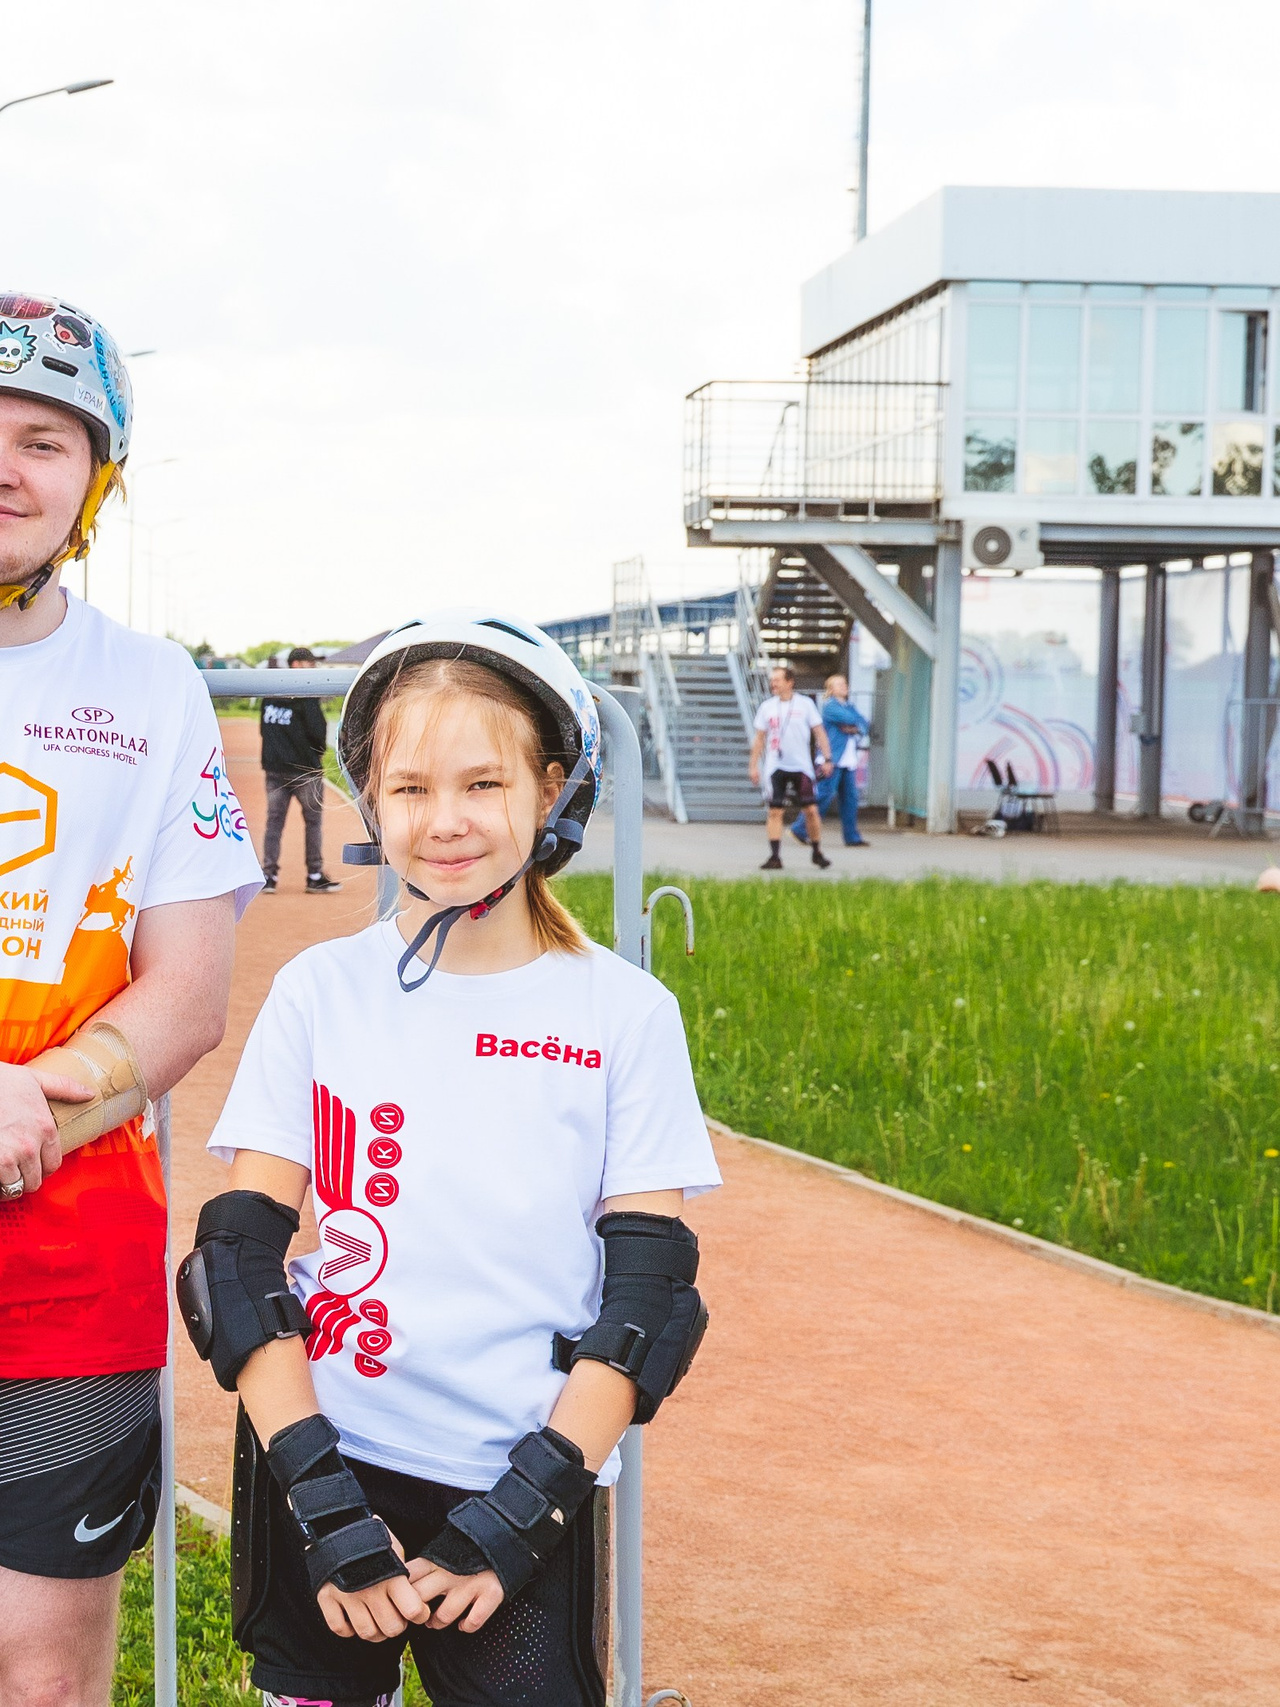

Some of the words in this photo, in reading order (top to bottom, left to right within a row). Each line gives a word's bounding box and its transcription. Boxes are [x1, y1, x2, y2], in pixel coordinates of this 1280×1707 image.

[82, 709, 103, 722] SP
[43, 743, 61, 753] UFA
[64, 744, 110, 759] CONGRESS
[113, 751, 138, 766] HOTEL
[475, 1033, 602, 1069] Васёна
